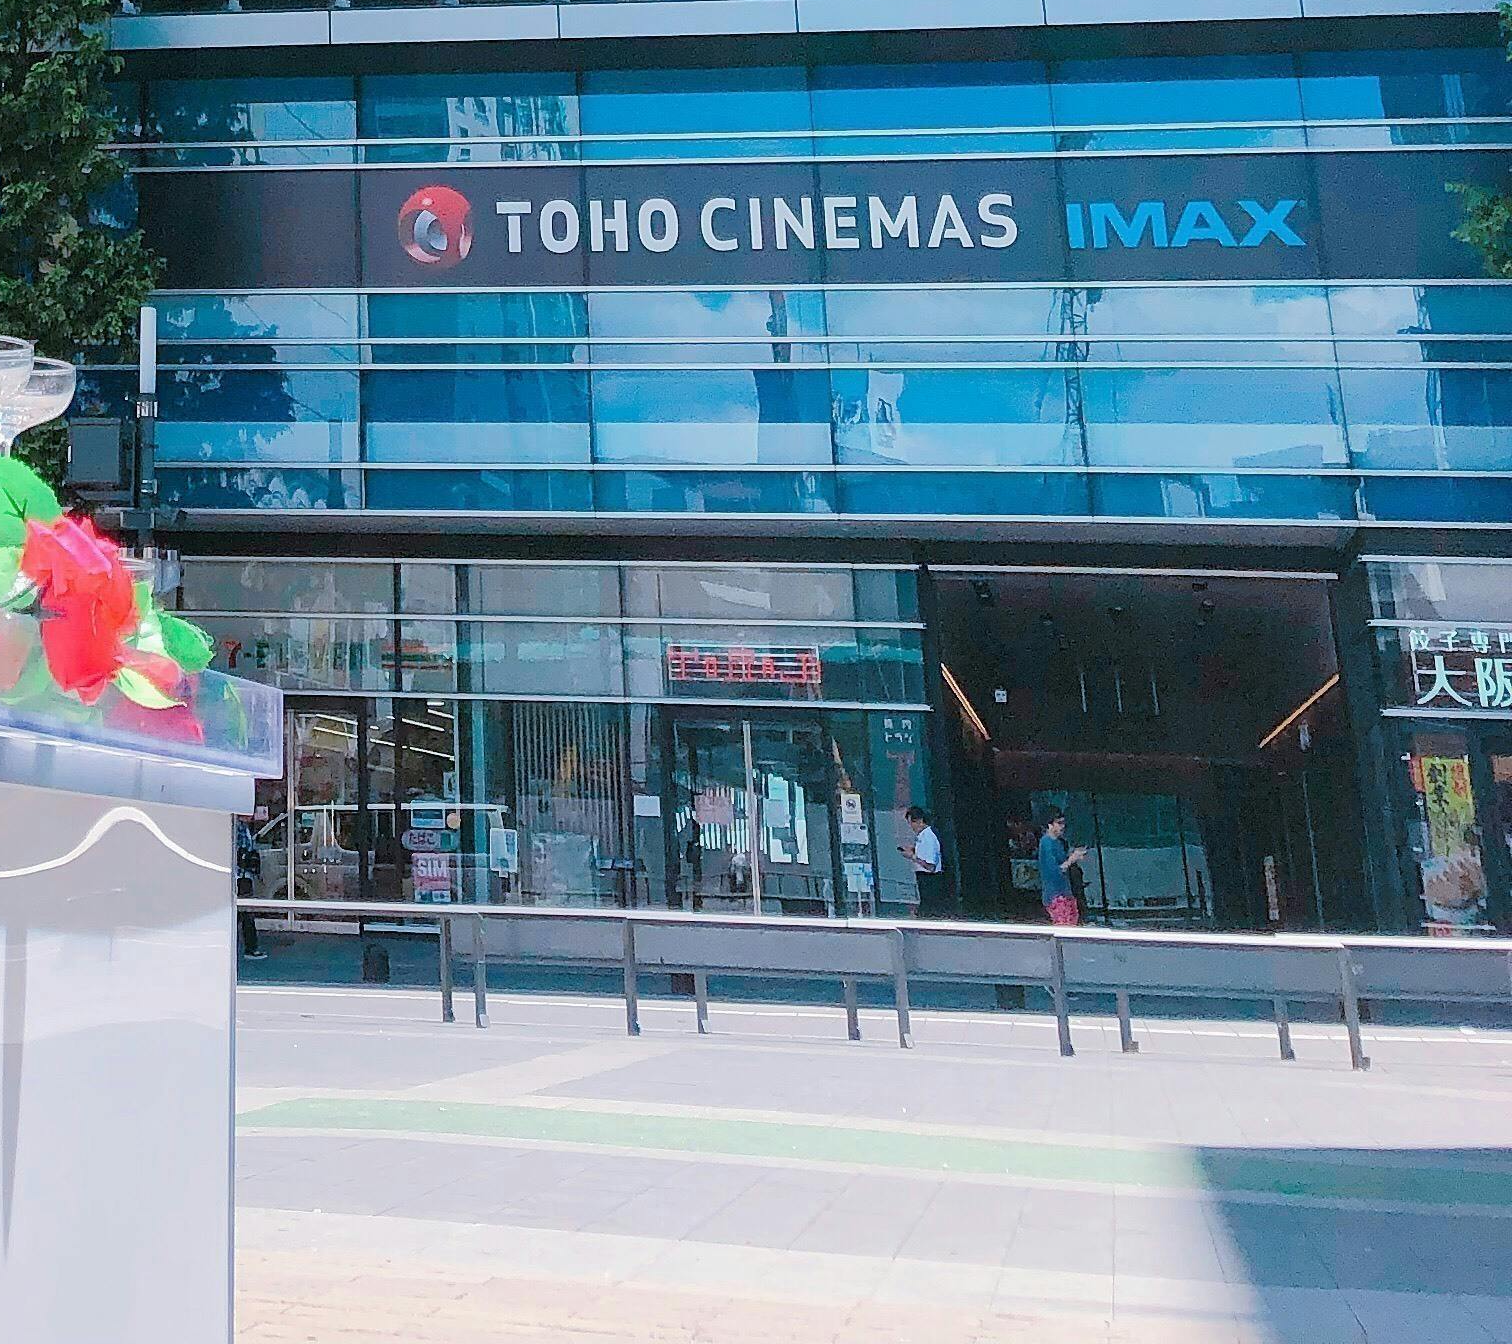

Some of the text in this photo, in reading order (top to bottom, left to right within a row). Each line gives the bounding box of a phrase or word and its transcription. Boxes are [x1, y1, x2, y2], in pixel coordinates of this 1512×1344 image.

[495, 193, 1307, 254] TOHO CINEMAS IMAX
[416, 858, 448, 878] SIM
